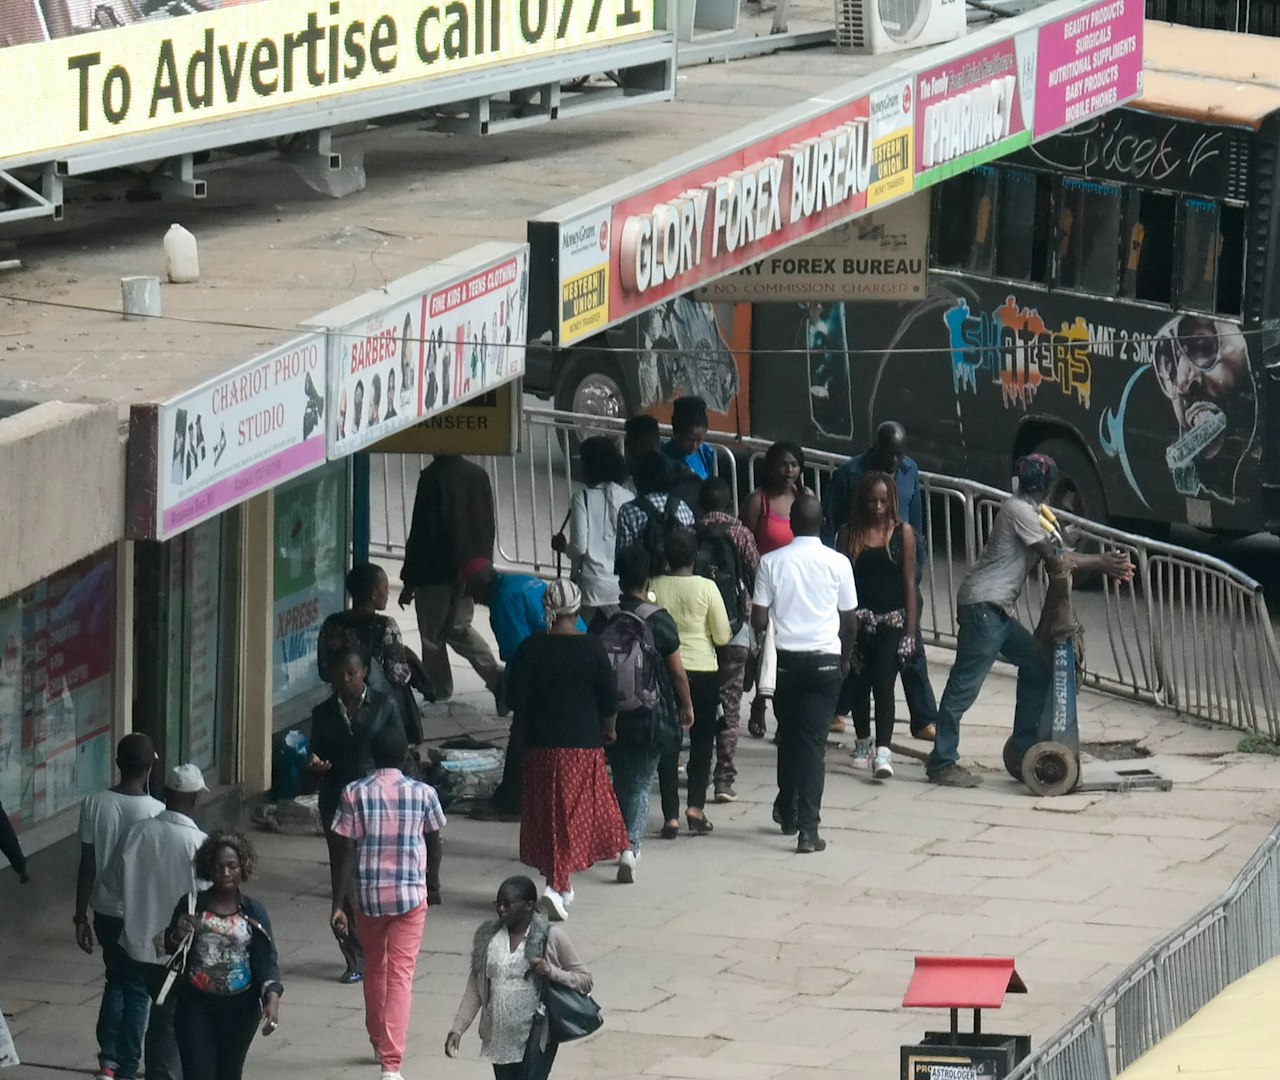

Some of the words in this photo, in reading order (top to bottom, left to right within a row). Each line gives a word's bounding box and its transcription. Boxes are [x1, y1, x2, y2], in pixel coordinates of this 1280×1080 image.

[1064, 14, 1089, 39] BEAUTY
[1091, 2, 1125, 28] PRODUCTS
[1075, 26, 1112, 54] SURGICALS
[68, 52, 131, 132] To
[149, 3, 398, 118] Advertise
[416, 0, 500, 64] call
[1048, 54, 1091, 87] NUTRITIONAL
[1092, 36, 1136, 66] SUPPLIMENTS
[921, 79, 930, 99] The
[931, 71, 948, 97] Family
[1065, 78, 1083, 101] BABY
[1084, 65, 1119, 92] PRODUCTS
[1065, 100, 1089, 123] MOBILE
[1090, 87, 1117, 113] PHONES
[923, 76, 1016, 166] PHARMACY
[873, 137, 901, 165] ESTERN
[878, 154, 901, 180] UNION
[628, 188, 708, 293] GLORY
[712, 160, 784, 258] FOREX
[789, 118, 872, 223] BUREAU
[562, 225, 596, 250] MoneyGram
[732, 259, 765, 275] RY
[771, 259, 836, 275] FOREX
[843, 259, 922, 275] BUREAU
[432, 295, 445, 314] FINE
[447, 289, 461, 308] KIDS
[487, 264, 516, 289] CLOTHING
[563, 272, 598, 302] WESTERN
[714, 284, 737, 294] NO
[744, 283, 835, 294] COMMISSION
[842, 282, 908, 293] CHARGED
[574, 289, 598, 316] UNION
[351, 326, 397, 374] BARBERS
[1120, 330, 1128, 359] 2
[212, 363, 270, 415] CHARIOT
[275, 344, 318, 385] PHOTO
[238, 402, 284, 447] STUDIO
[413, 415, 488, 430] ANSFER
[932, 1068, 975, 1080] ASTROLOGER
